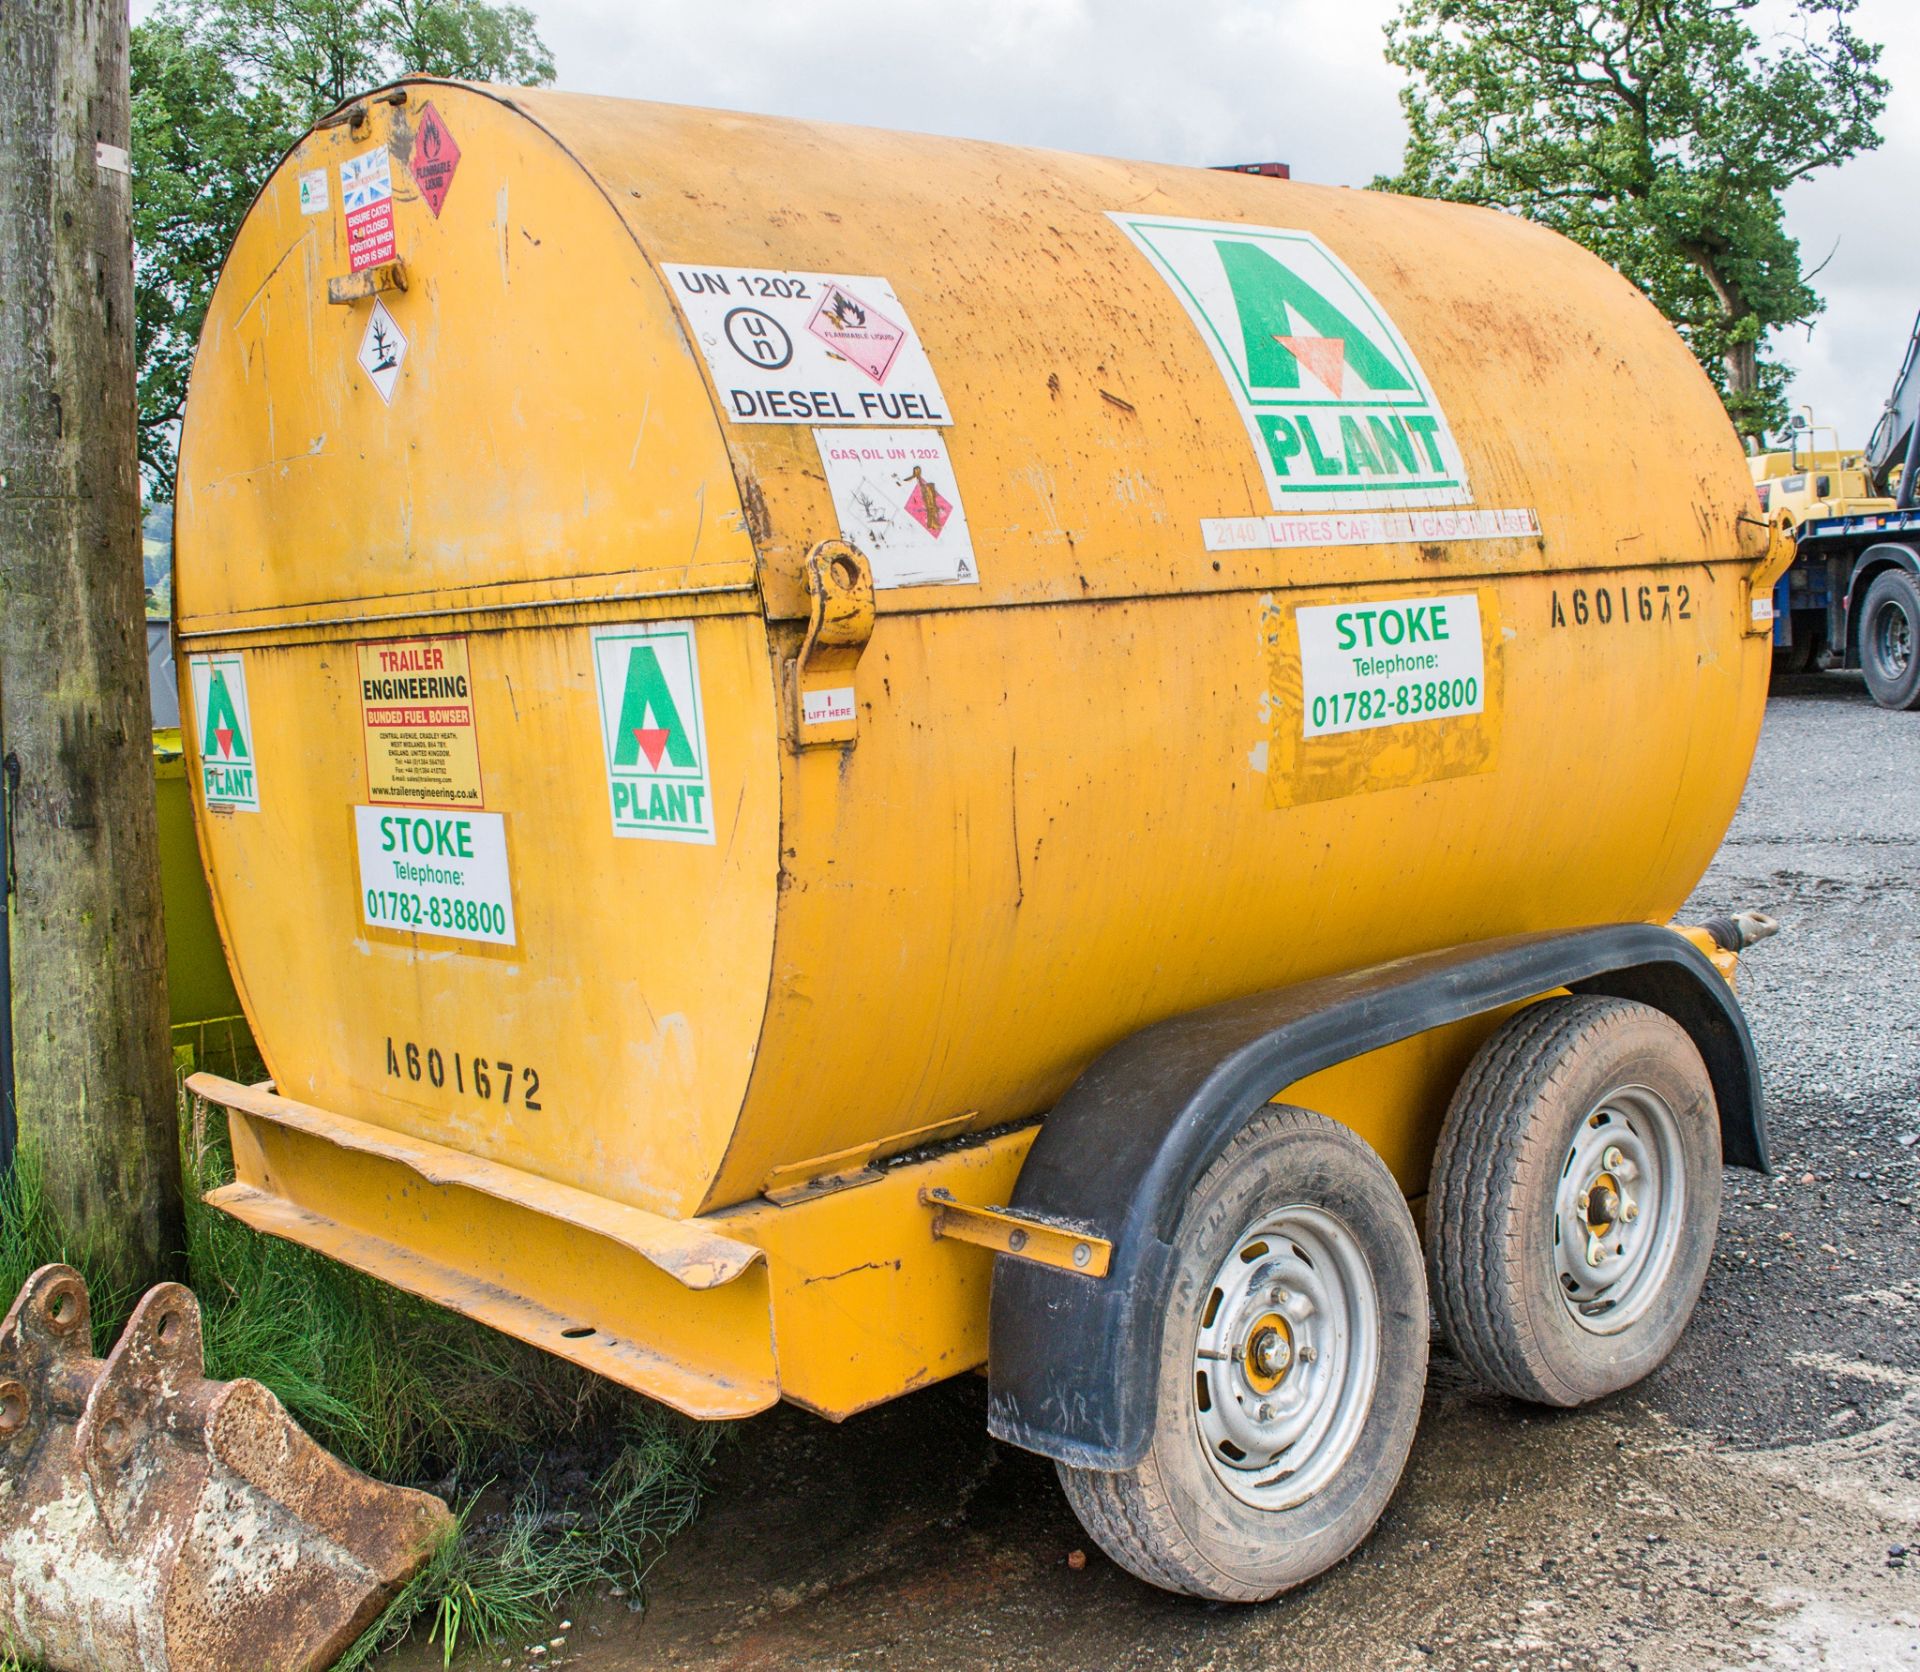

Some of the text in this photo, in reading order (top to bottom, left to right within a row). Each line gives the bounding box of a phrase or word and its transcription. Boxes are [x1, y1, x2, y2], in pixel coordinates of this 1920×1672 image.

[416, 161, 451, 178] FLAMMABLE
[433, 194, 438, 207] 3
[348, 203, 391, 227] ENSURE CATCH
[366, 218, 389, 234] CLOSED
[350, 230, 394, 255] POSITION WHEN
[353, 245, 392, 267] DOOR IS SHUT
[678, 272, 811, 299] UN 1202
[824, 331, 868, 339] FLAMMABLE
[870, 365, 879, 376] 3
[731, 389, 942, 419] DIESEL FUEL
[830, 449, 940, 460] GAS OIL UN 1202
[1254, 415, 1447, 476] PLANT
[1214, 523, 1257, 545] 2140
[1270, 521, 1334, 543] LITRES
[1422, 517, 1457, 537] GAS
[1551, 584, 1691, 628] A601672
[1335, 605, 1450, 651] STOKE
[379, 648, 444, 673] TRAILER
[1352, 653, 1438, 679] Telephone:
[363, 675, 468, 700] ENGINEERING
[614, 646, 698, 768] A
[808, 708, 851, 719] LIFT HERE
[1312, 677, 1478, 728] 01782-838800
[368, 710, 469, 724] BUNDED FUEL BOWSER
[204, 768, 253, 797] PLANT
[372, 786, 478, 800] www.trailerengineering.co.uk
[612, 782, 704, 824] PLANT
[380, 816, 474, 858] STOKE
[393, 860, 464, 886] Telephone:
[367, 889, 506, 935] 01782-838800
[387, 1037, 541, 1111] A601672
